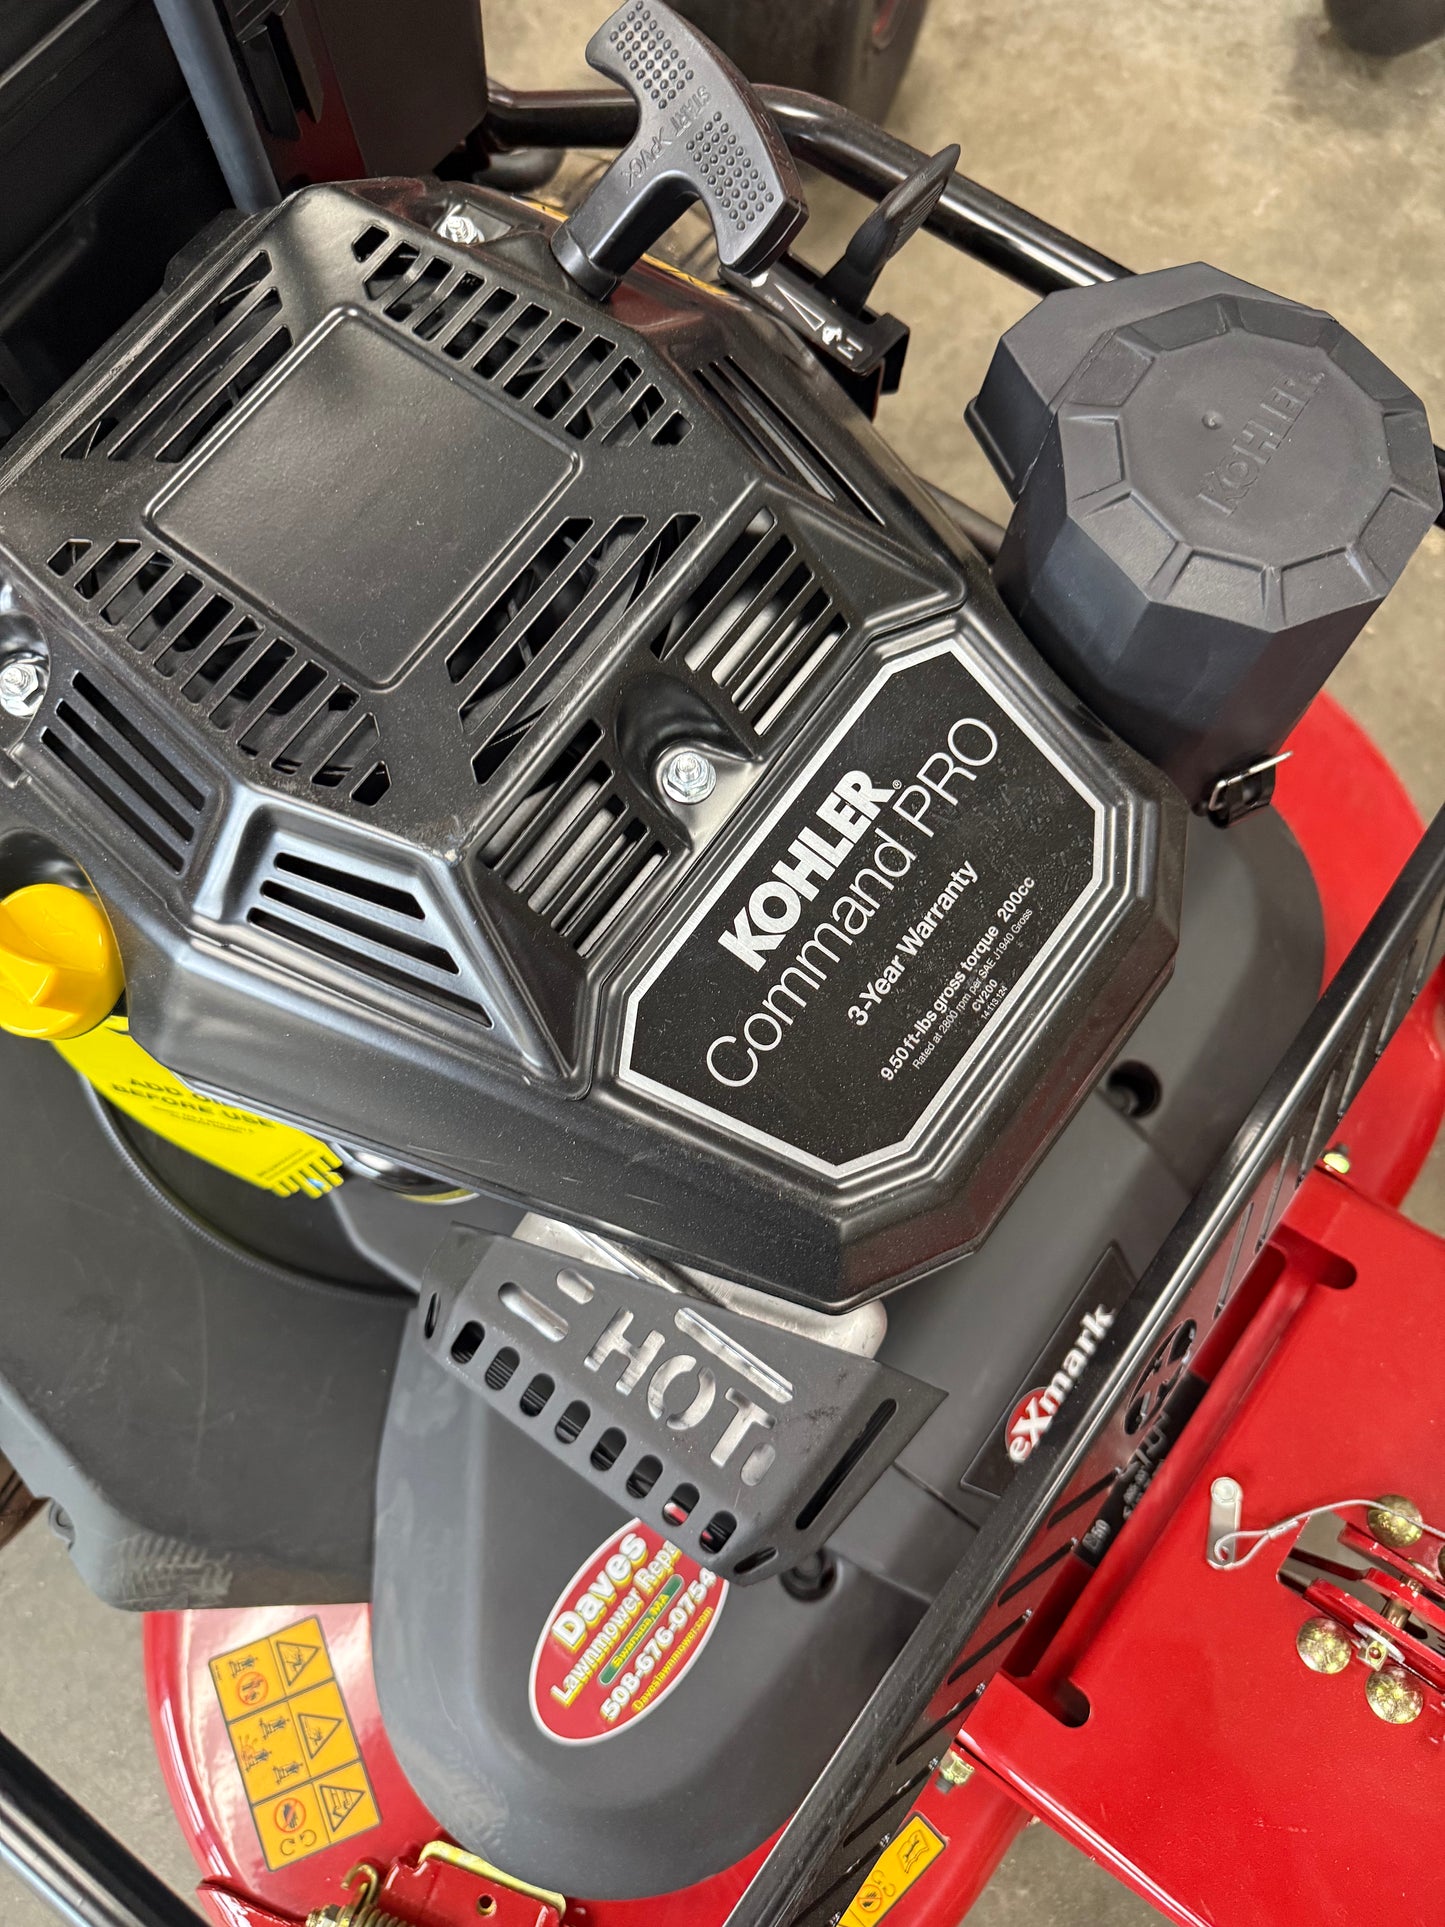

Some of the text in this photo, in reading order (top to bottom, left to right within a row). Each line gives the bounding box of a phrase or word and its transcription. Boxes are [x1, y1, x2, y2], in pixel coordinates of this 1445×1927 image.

[669, 84, 711, 137] START
[706, 717, 998, 1087] Command PRO
[847, 860, 978, 1026] 3-Year Warranty
[880, 877, 1035, 1080] 9.50 ft-lbs gross torque 200cc
[912, 908, 1033, 1070] Rated at 2800 rpm per SAE J1940 Gross
[972, 978, 998, 1012] CV200
[112, 1083, 215, 1115] BEFORE
[221, 1109, 276, 1129] USE
[130, 1078, 183, 1096] ADD
[584, 1306, 777, 1468] HOT
[550, 1540, 682, 1706] Lawnmower Repa
[551, 1533, 648, 1652] Daves
[600, 1567, 717, 1722] 508-676-0754
[649, 1593, 670, 1616] MA
